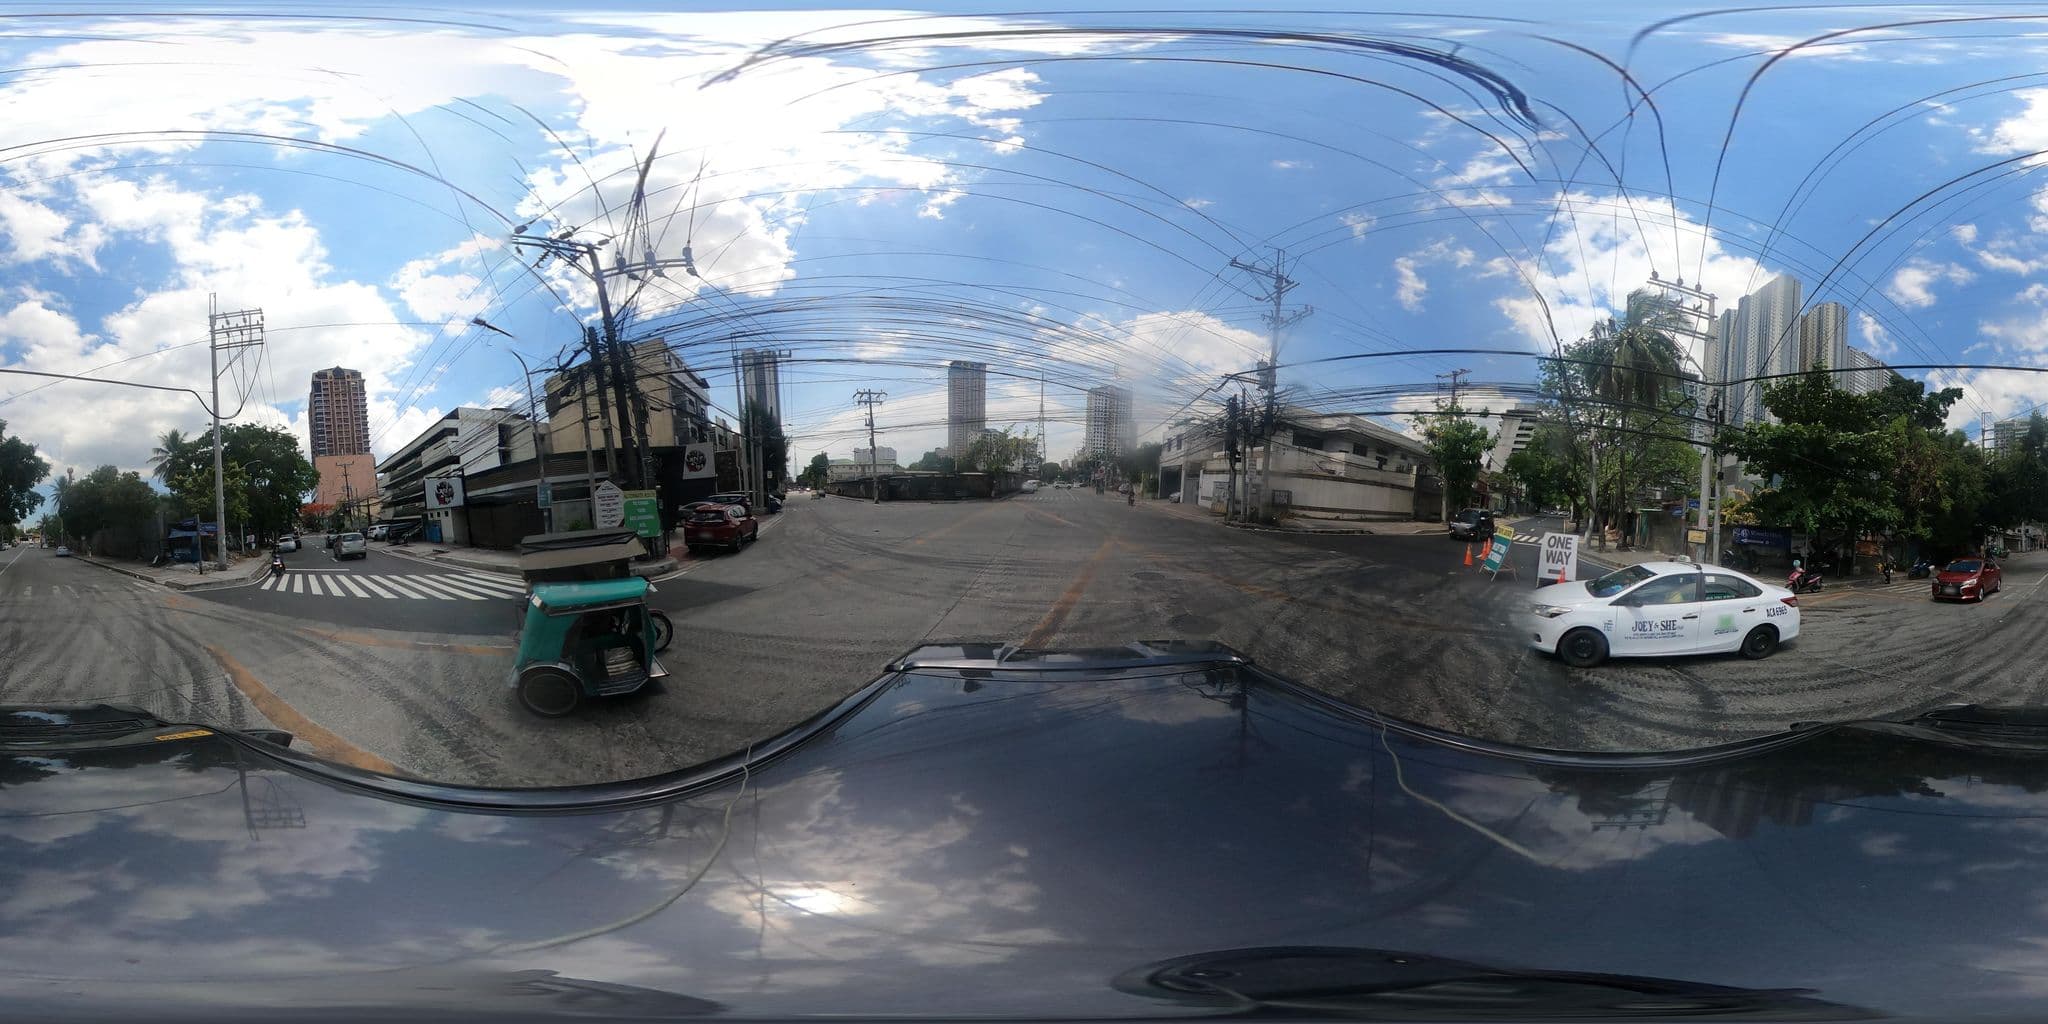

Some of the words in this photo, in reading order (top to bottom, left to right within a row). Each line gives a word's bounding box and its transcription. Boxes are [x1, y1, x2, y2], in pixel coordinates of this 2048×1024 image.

[1547, 535, 1573, 550] ONE
[1546, 549, 1572, 565] WAY
[1632, 620, 1653, 632] JOEY
[1660, 619, 1677, 631] SHE
